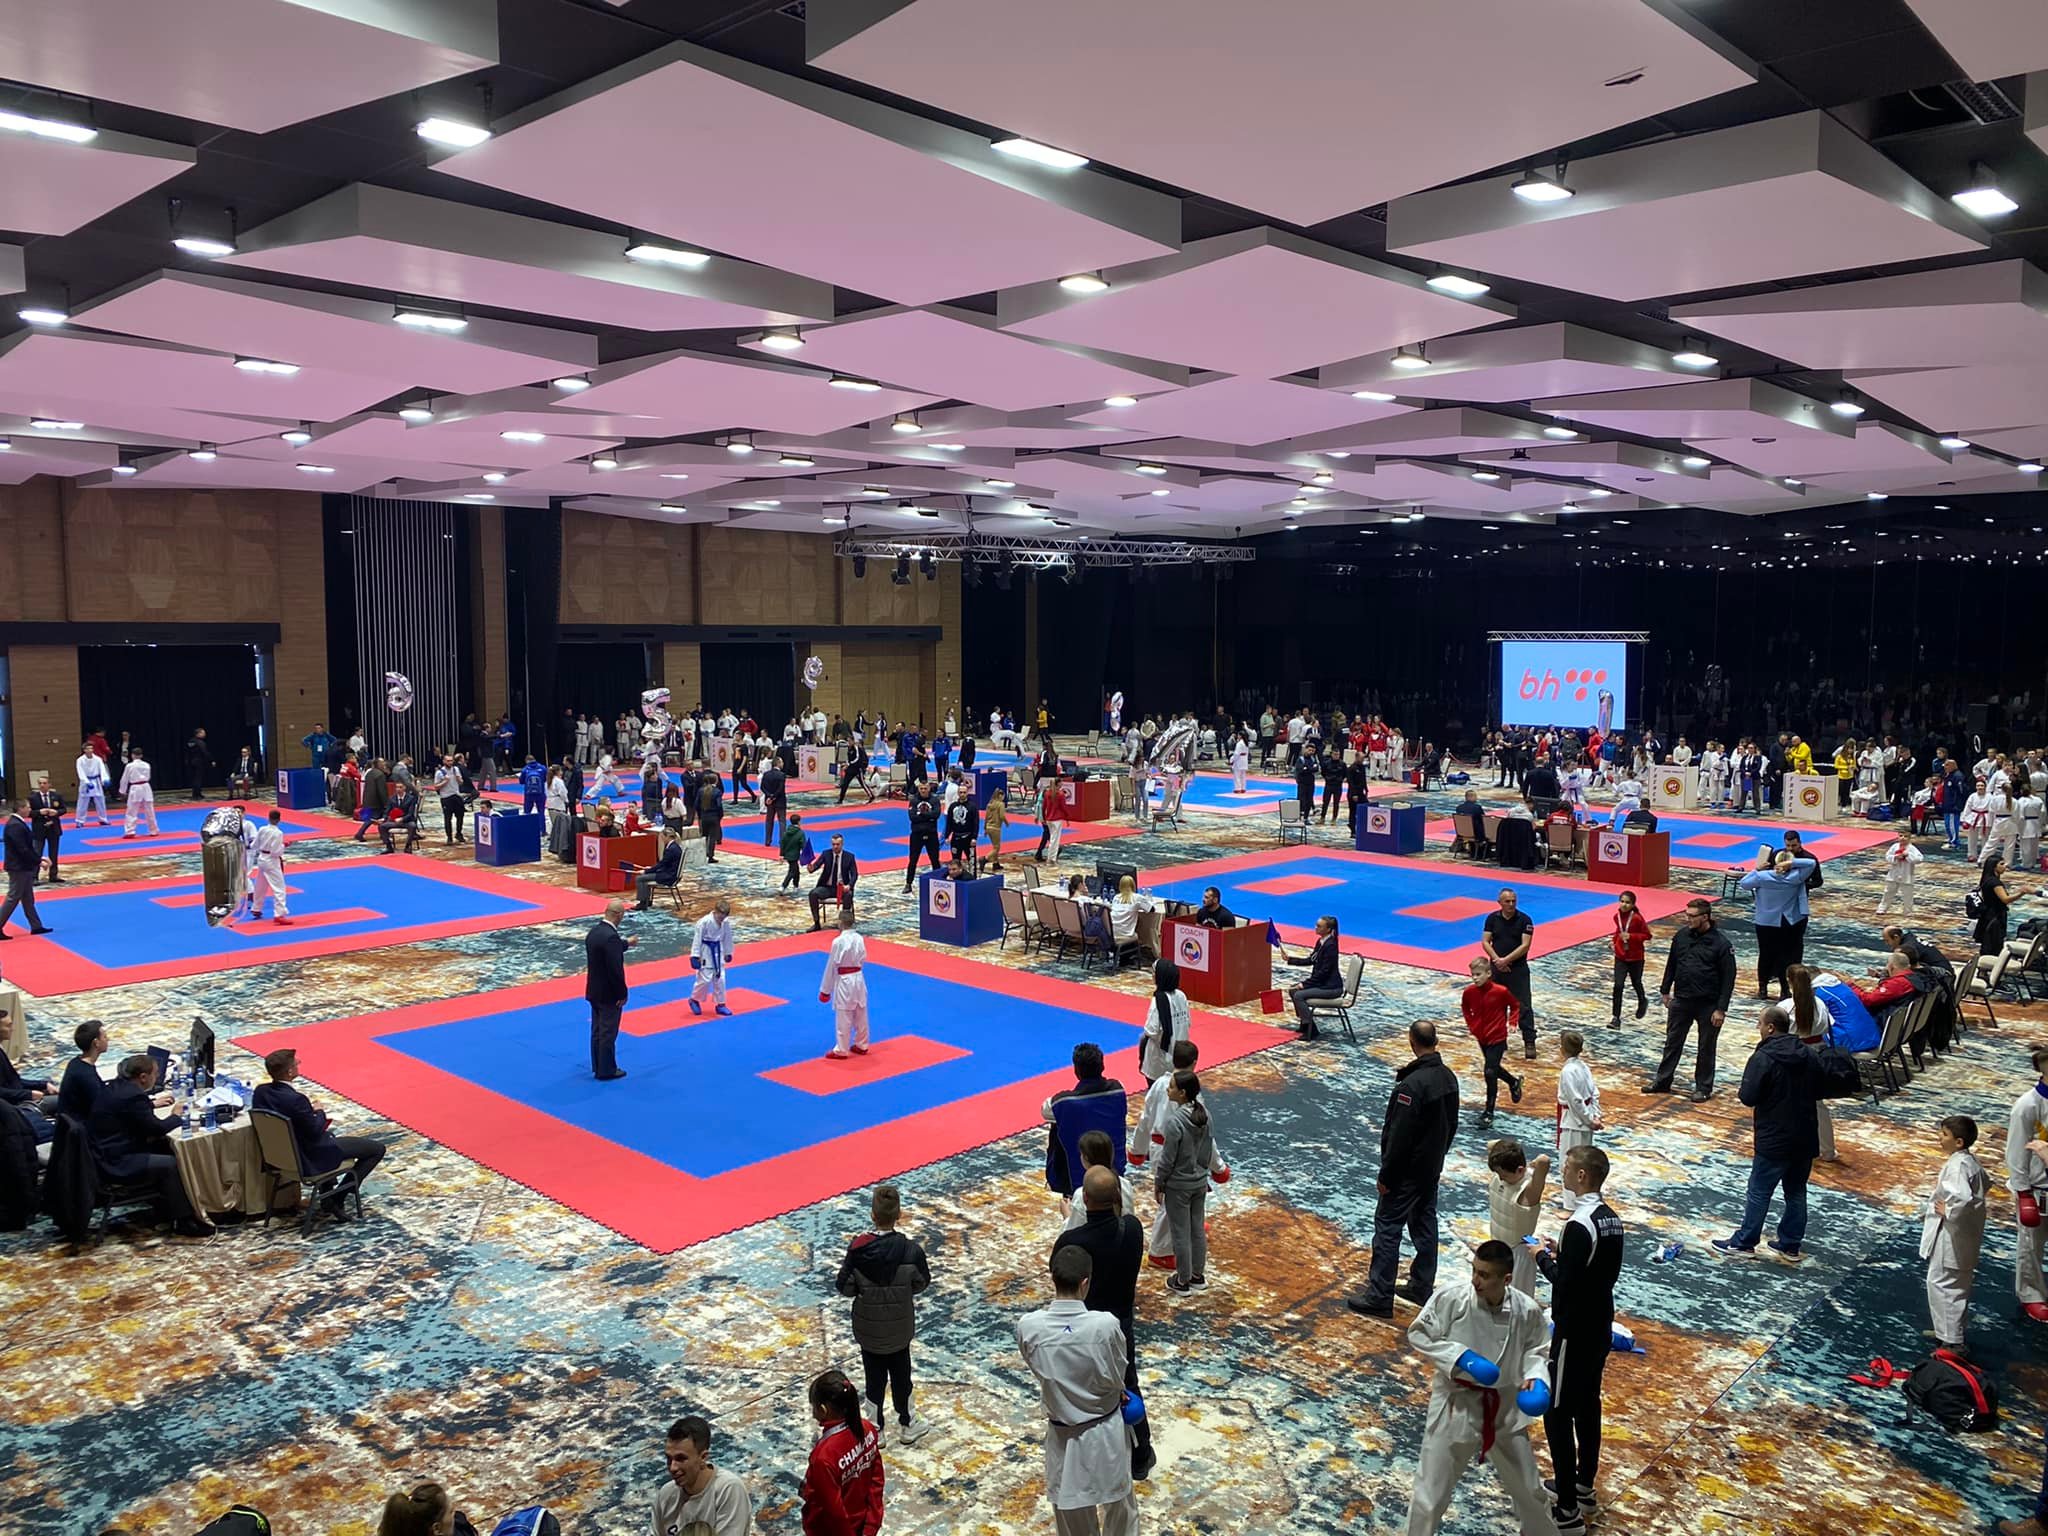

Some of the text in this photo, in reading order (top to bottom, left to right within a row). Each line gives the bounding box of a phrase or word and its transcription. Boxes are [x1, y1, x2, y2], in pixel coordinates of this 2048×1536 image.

[1520, 668, 1560, 700] bh
[1180, 928, 1203, 936] COACH
[838, 1430, 875, 1469] CHAMION
